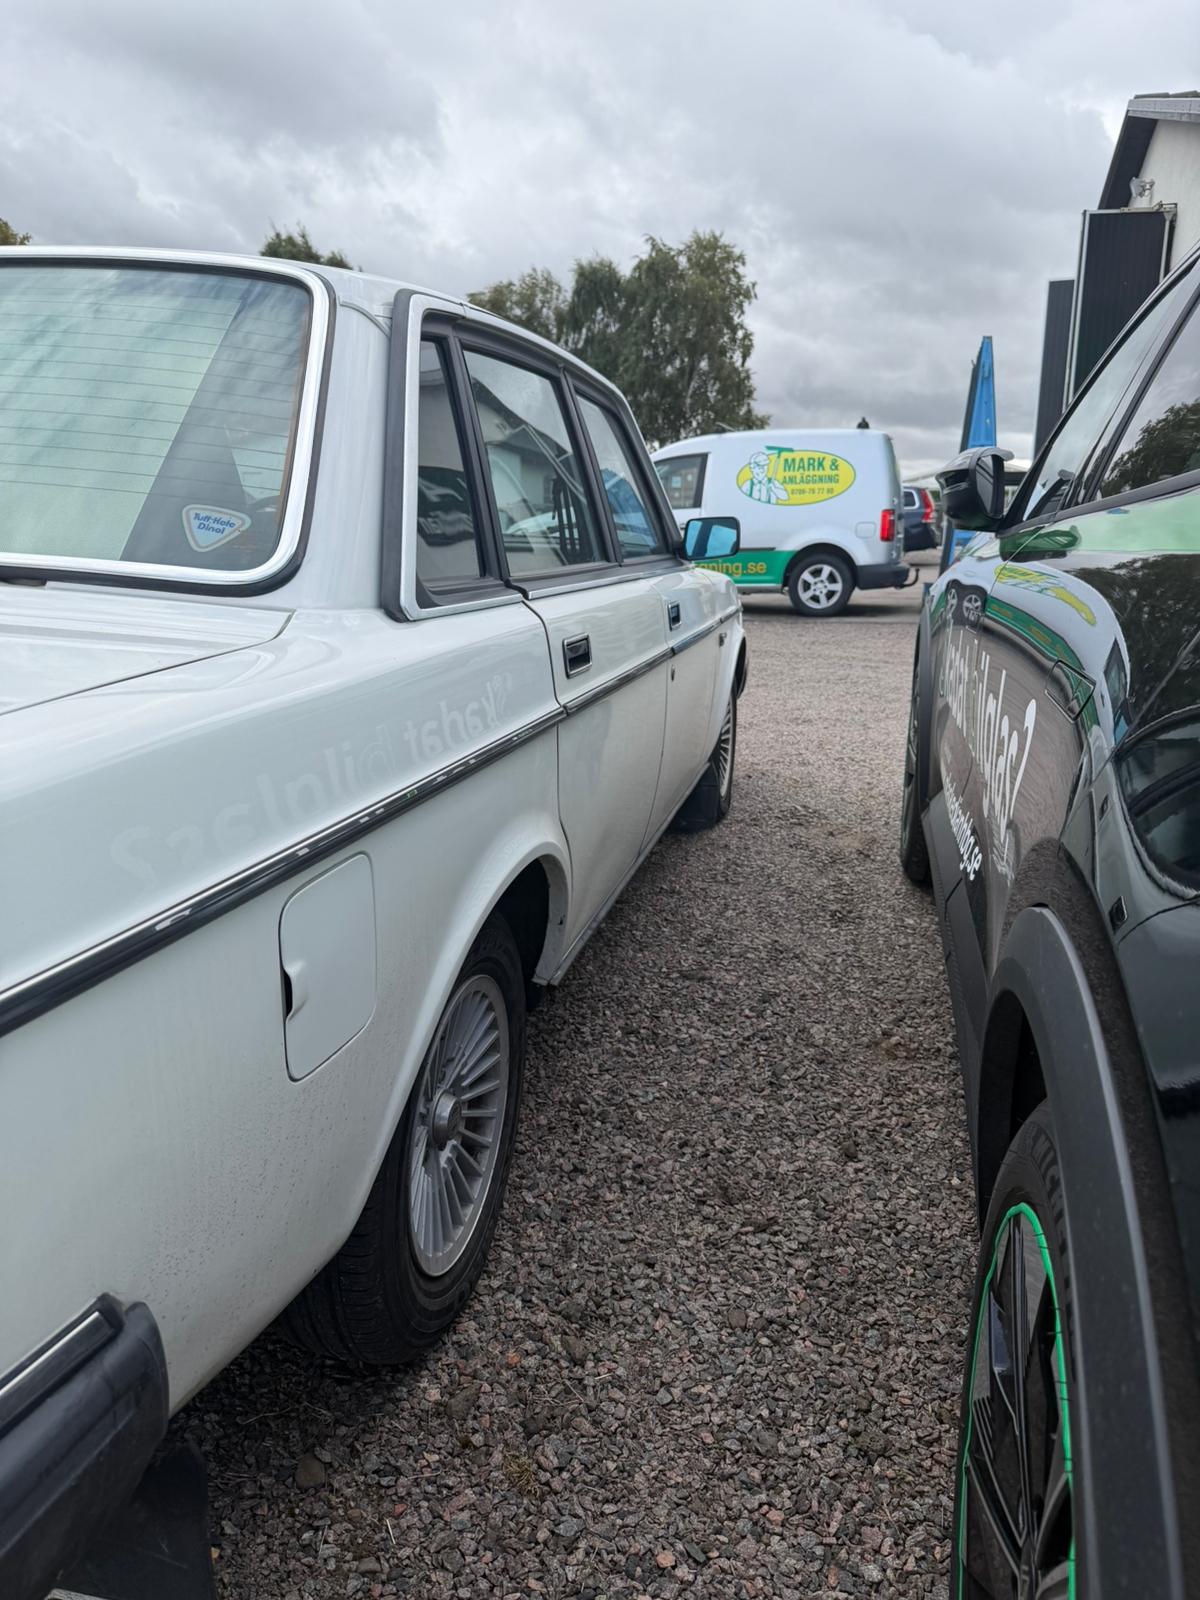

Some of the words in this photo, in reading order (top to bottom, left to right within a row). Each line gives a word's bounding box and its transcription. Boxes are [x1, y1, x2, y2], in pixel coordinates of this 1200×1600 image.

[783, 457, 826, 472] MARK
[829, 458, 839, 471] &
[781, 473, 840, 485] ANLÄGGNING
[197, 522, 225, 534] Dinol
